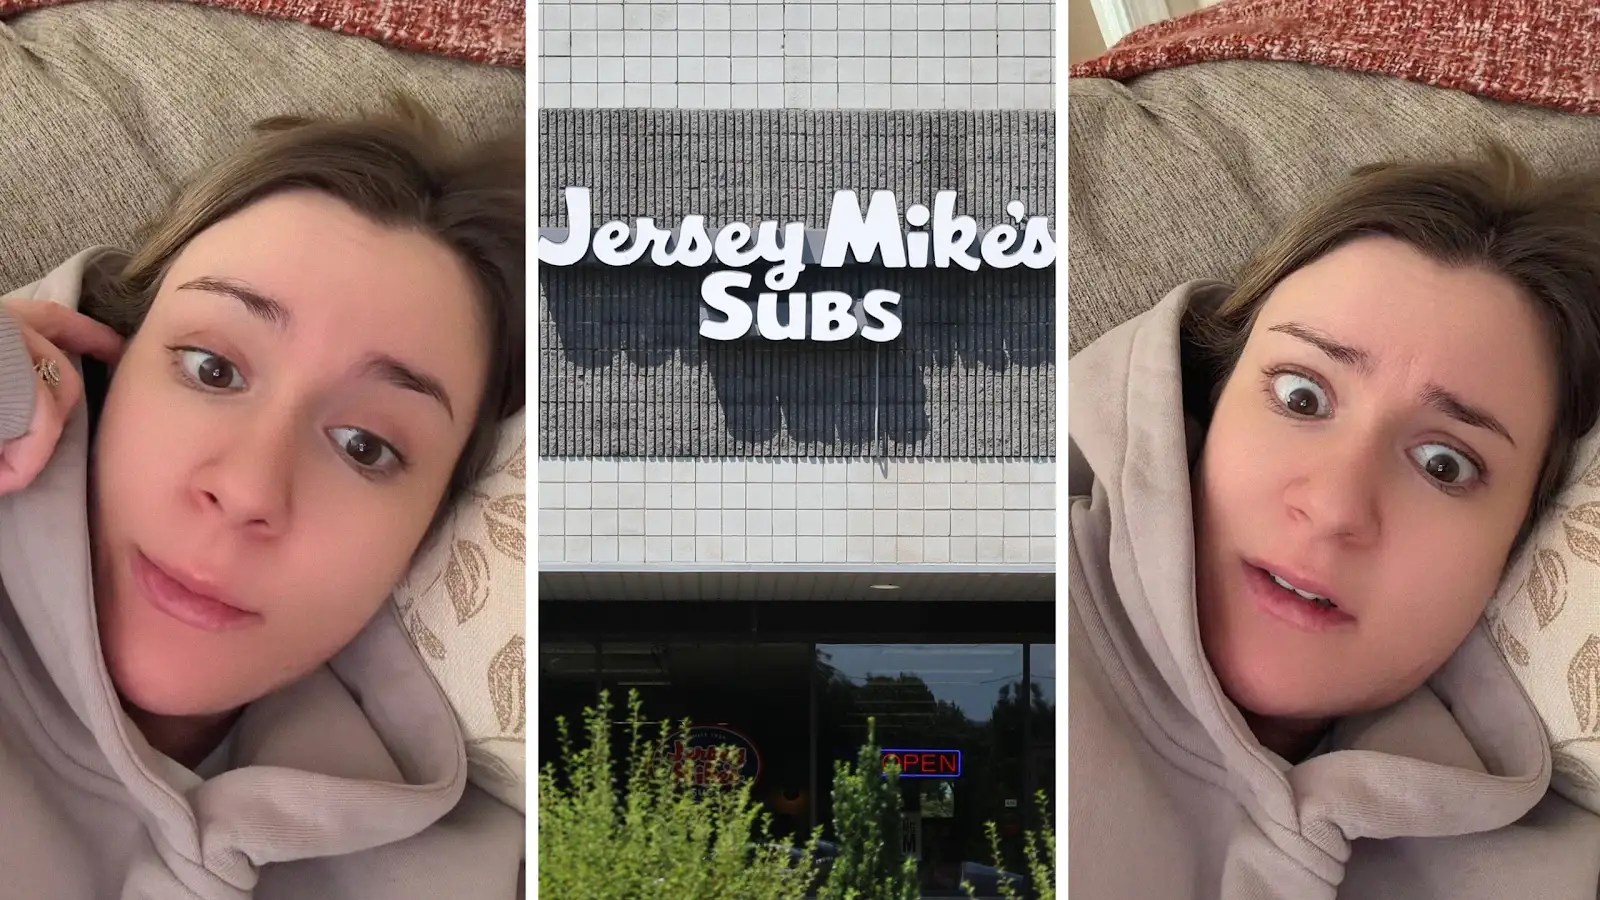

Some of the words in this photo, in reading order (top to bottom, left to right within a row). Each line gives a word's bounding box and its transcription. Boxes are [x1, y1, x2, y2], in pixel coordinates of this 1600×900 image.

[538, 186, 806, 291] Jersey
[820, 189, 1056, 272] Mike's
[882, 753, 956, 773] OPEN
